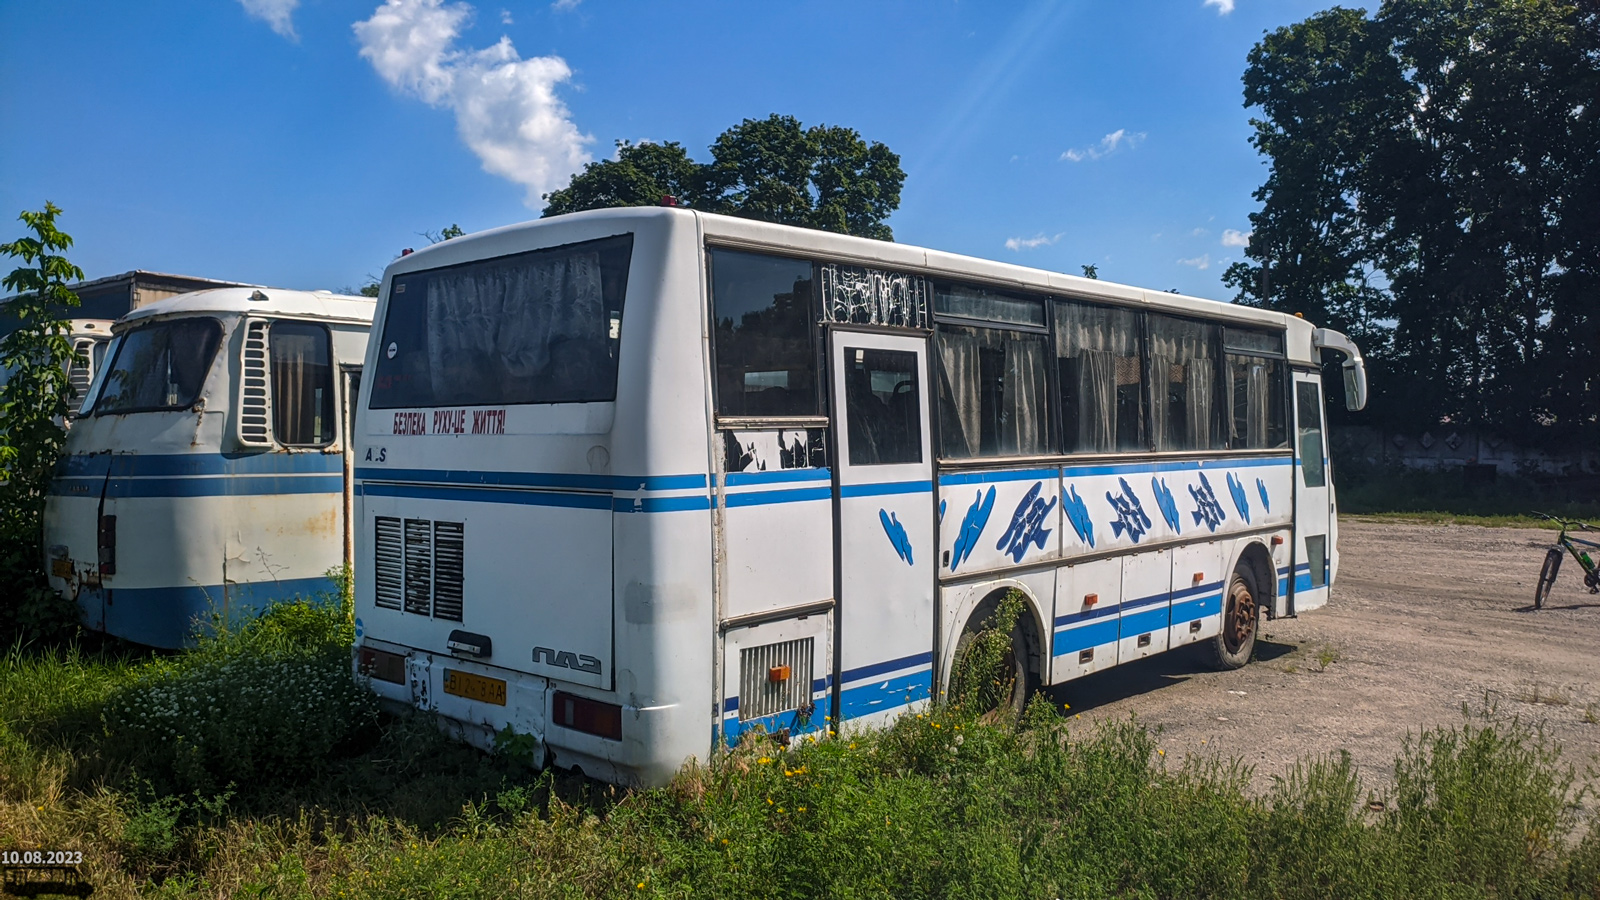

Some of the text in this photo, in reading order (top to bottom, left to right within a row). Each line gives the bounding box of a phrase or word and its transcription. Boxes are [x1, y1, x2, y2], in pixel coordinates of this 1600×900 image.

[393, 412, 426, 435] БЕЗПЕКА
[471, 409, 506, 434] ЖИТТЯ!
[532, 646, 602, 675] ПАЗ
[464, 678, 487, 697] 28
[489, 683, 503, 701] AA
